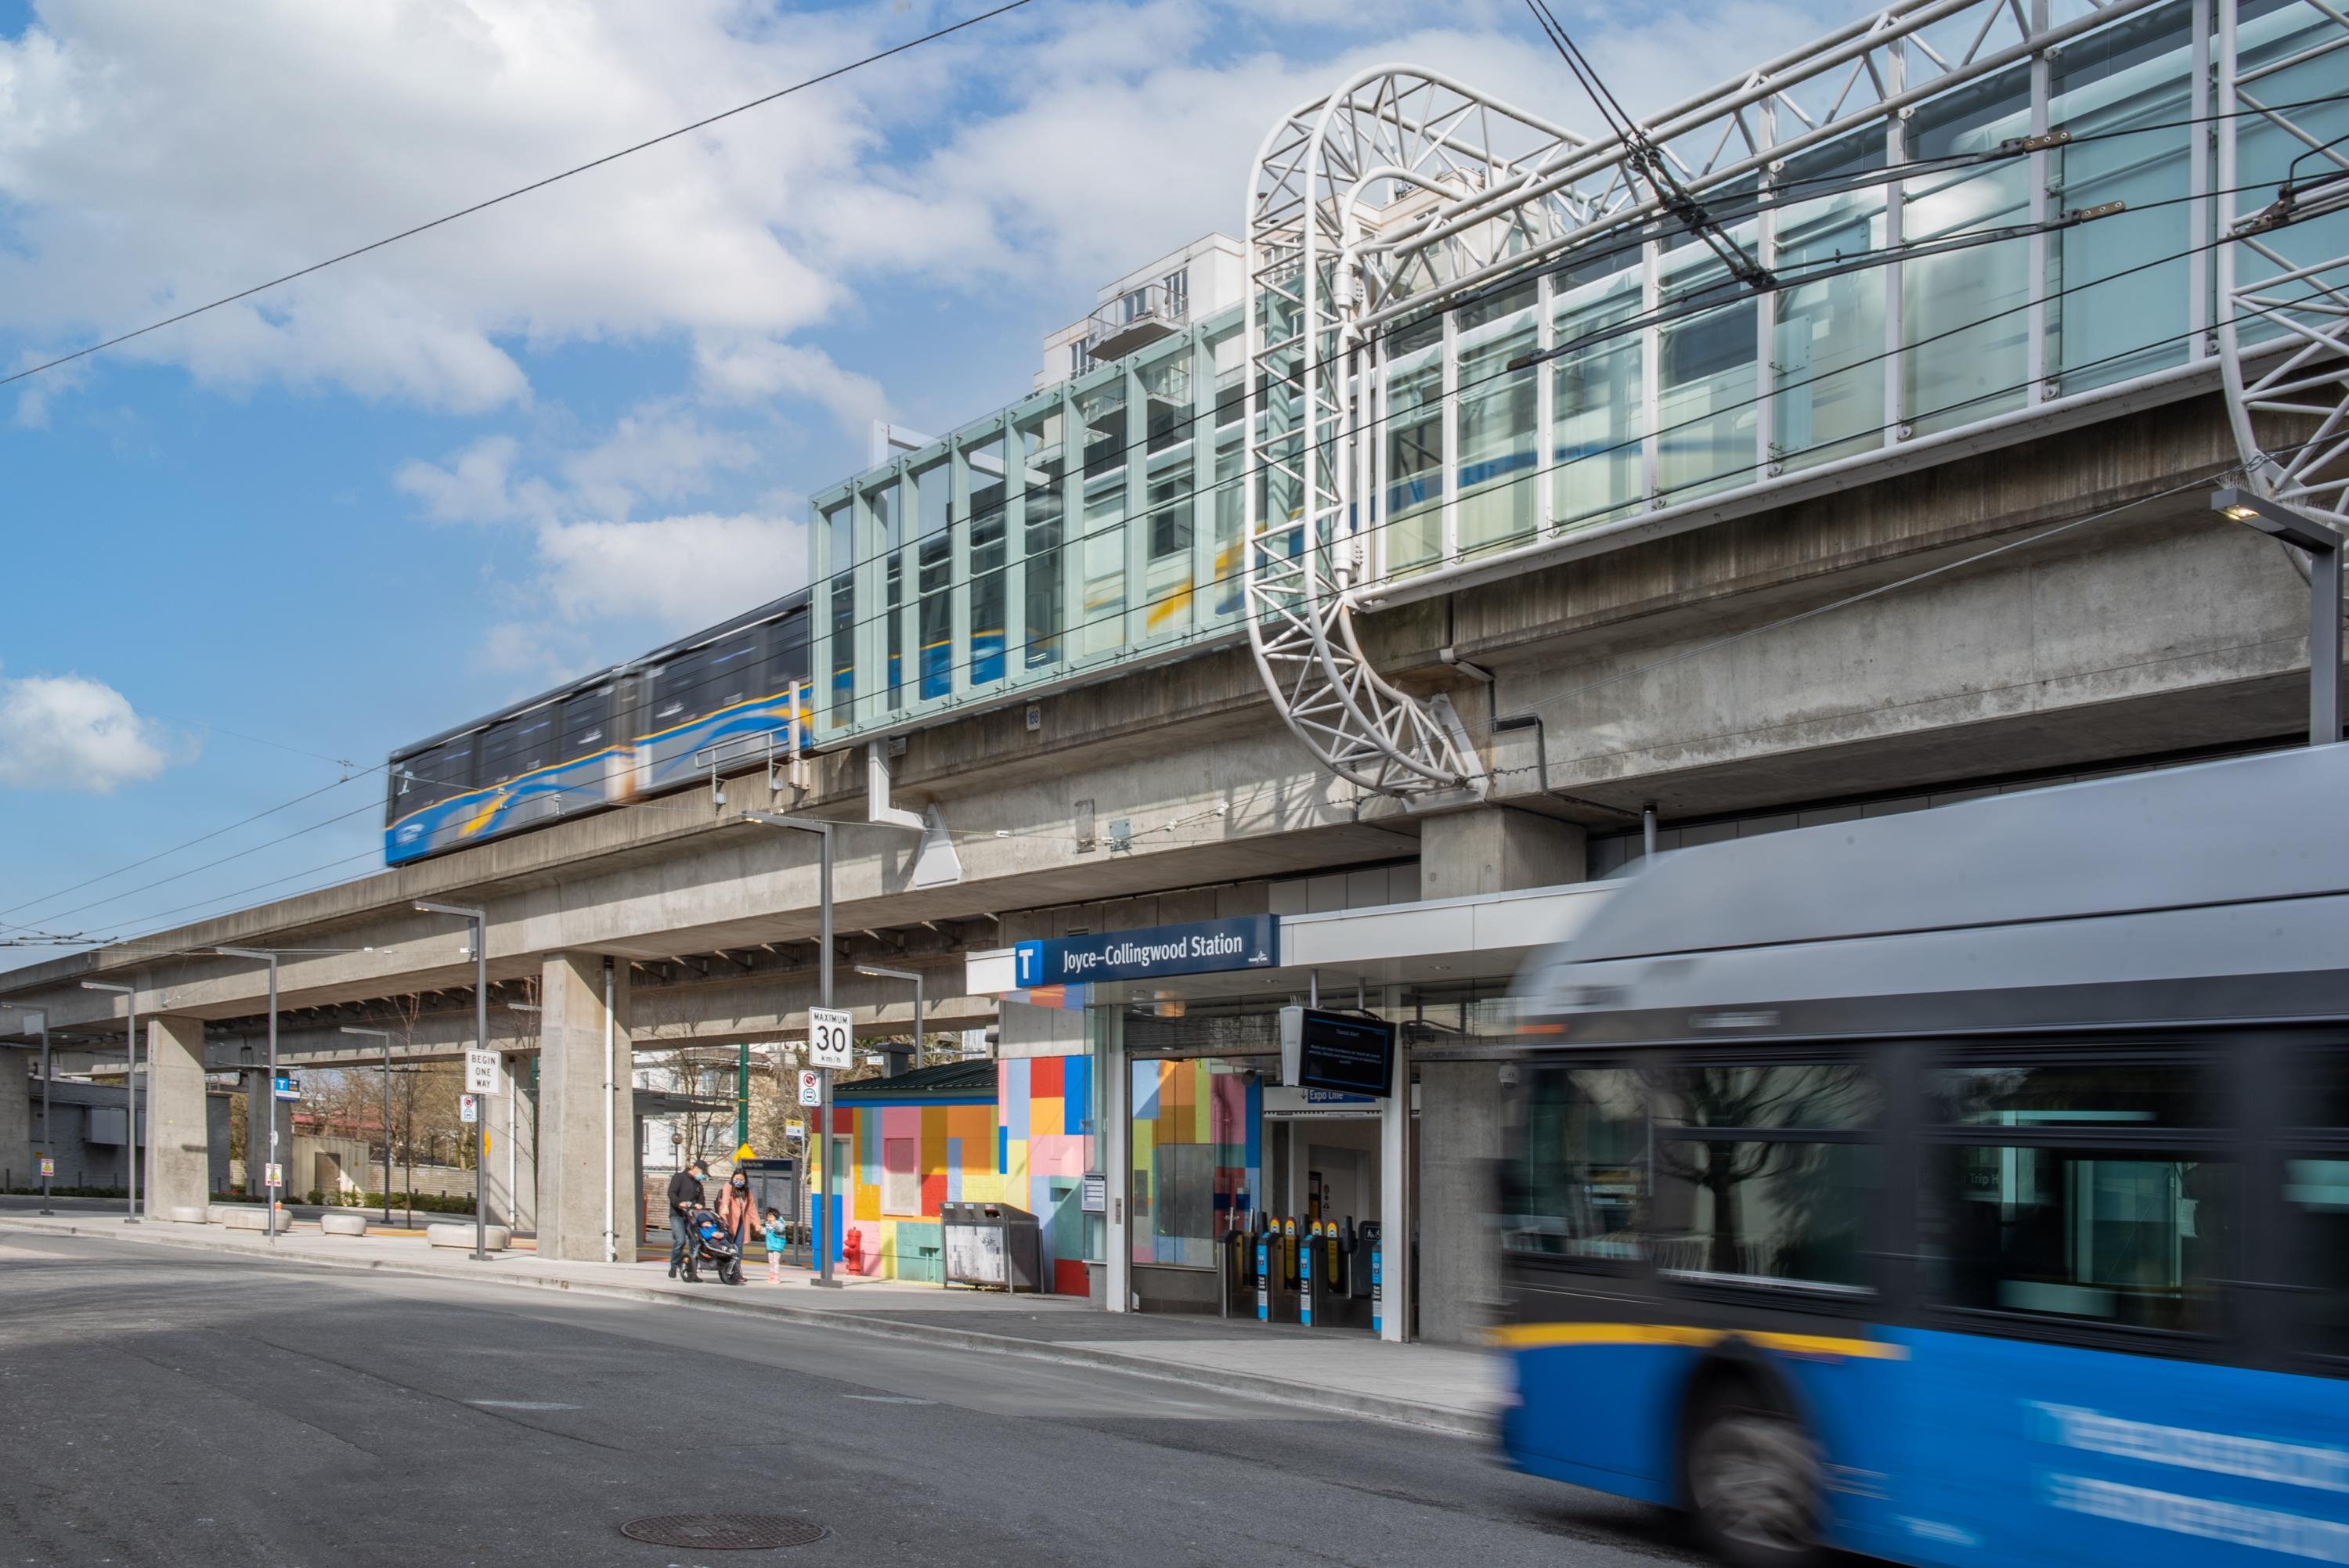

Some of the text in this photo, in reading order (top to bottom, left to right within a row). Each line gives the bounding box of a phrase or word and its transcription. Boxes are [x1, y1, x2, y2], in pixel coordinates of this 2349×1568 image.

[1019, 949, 1034, 979] T
[1191, 932, 1242, 957] Station
[814, 1012, 848, 1024] MAXIMUM
[817, 1025, 846, 1052] 30
[471, 1054, 496, 1065] BEGIN
[821, 1054, 841, 1063] km/h
[475, 1067, 491, 1076] ONE
[476, 1079, 491, 1088] WAY
[1309, 1089, 1327, 1102] Expo
